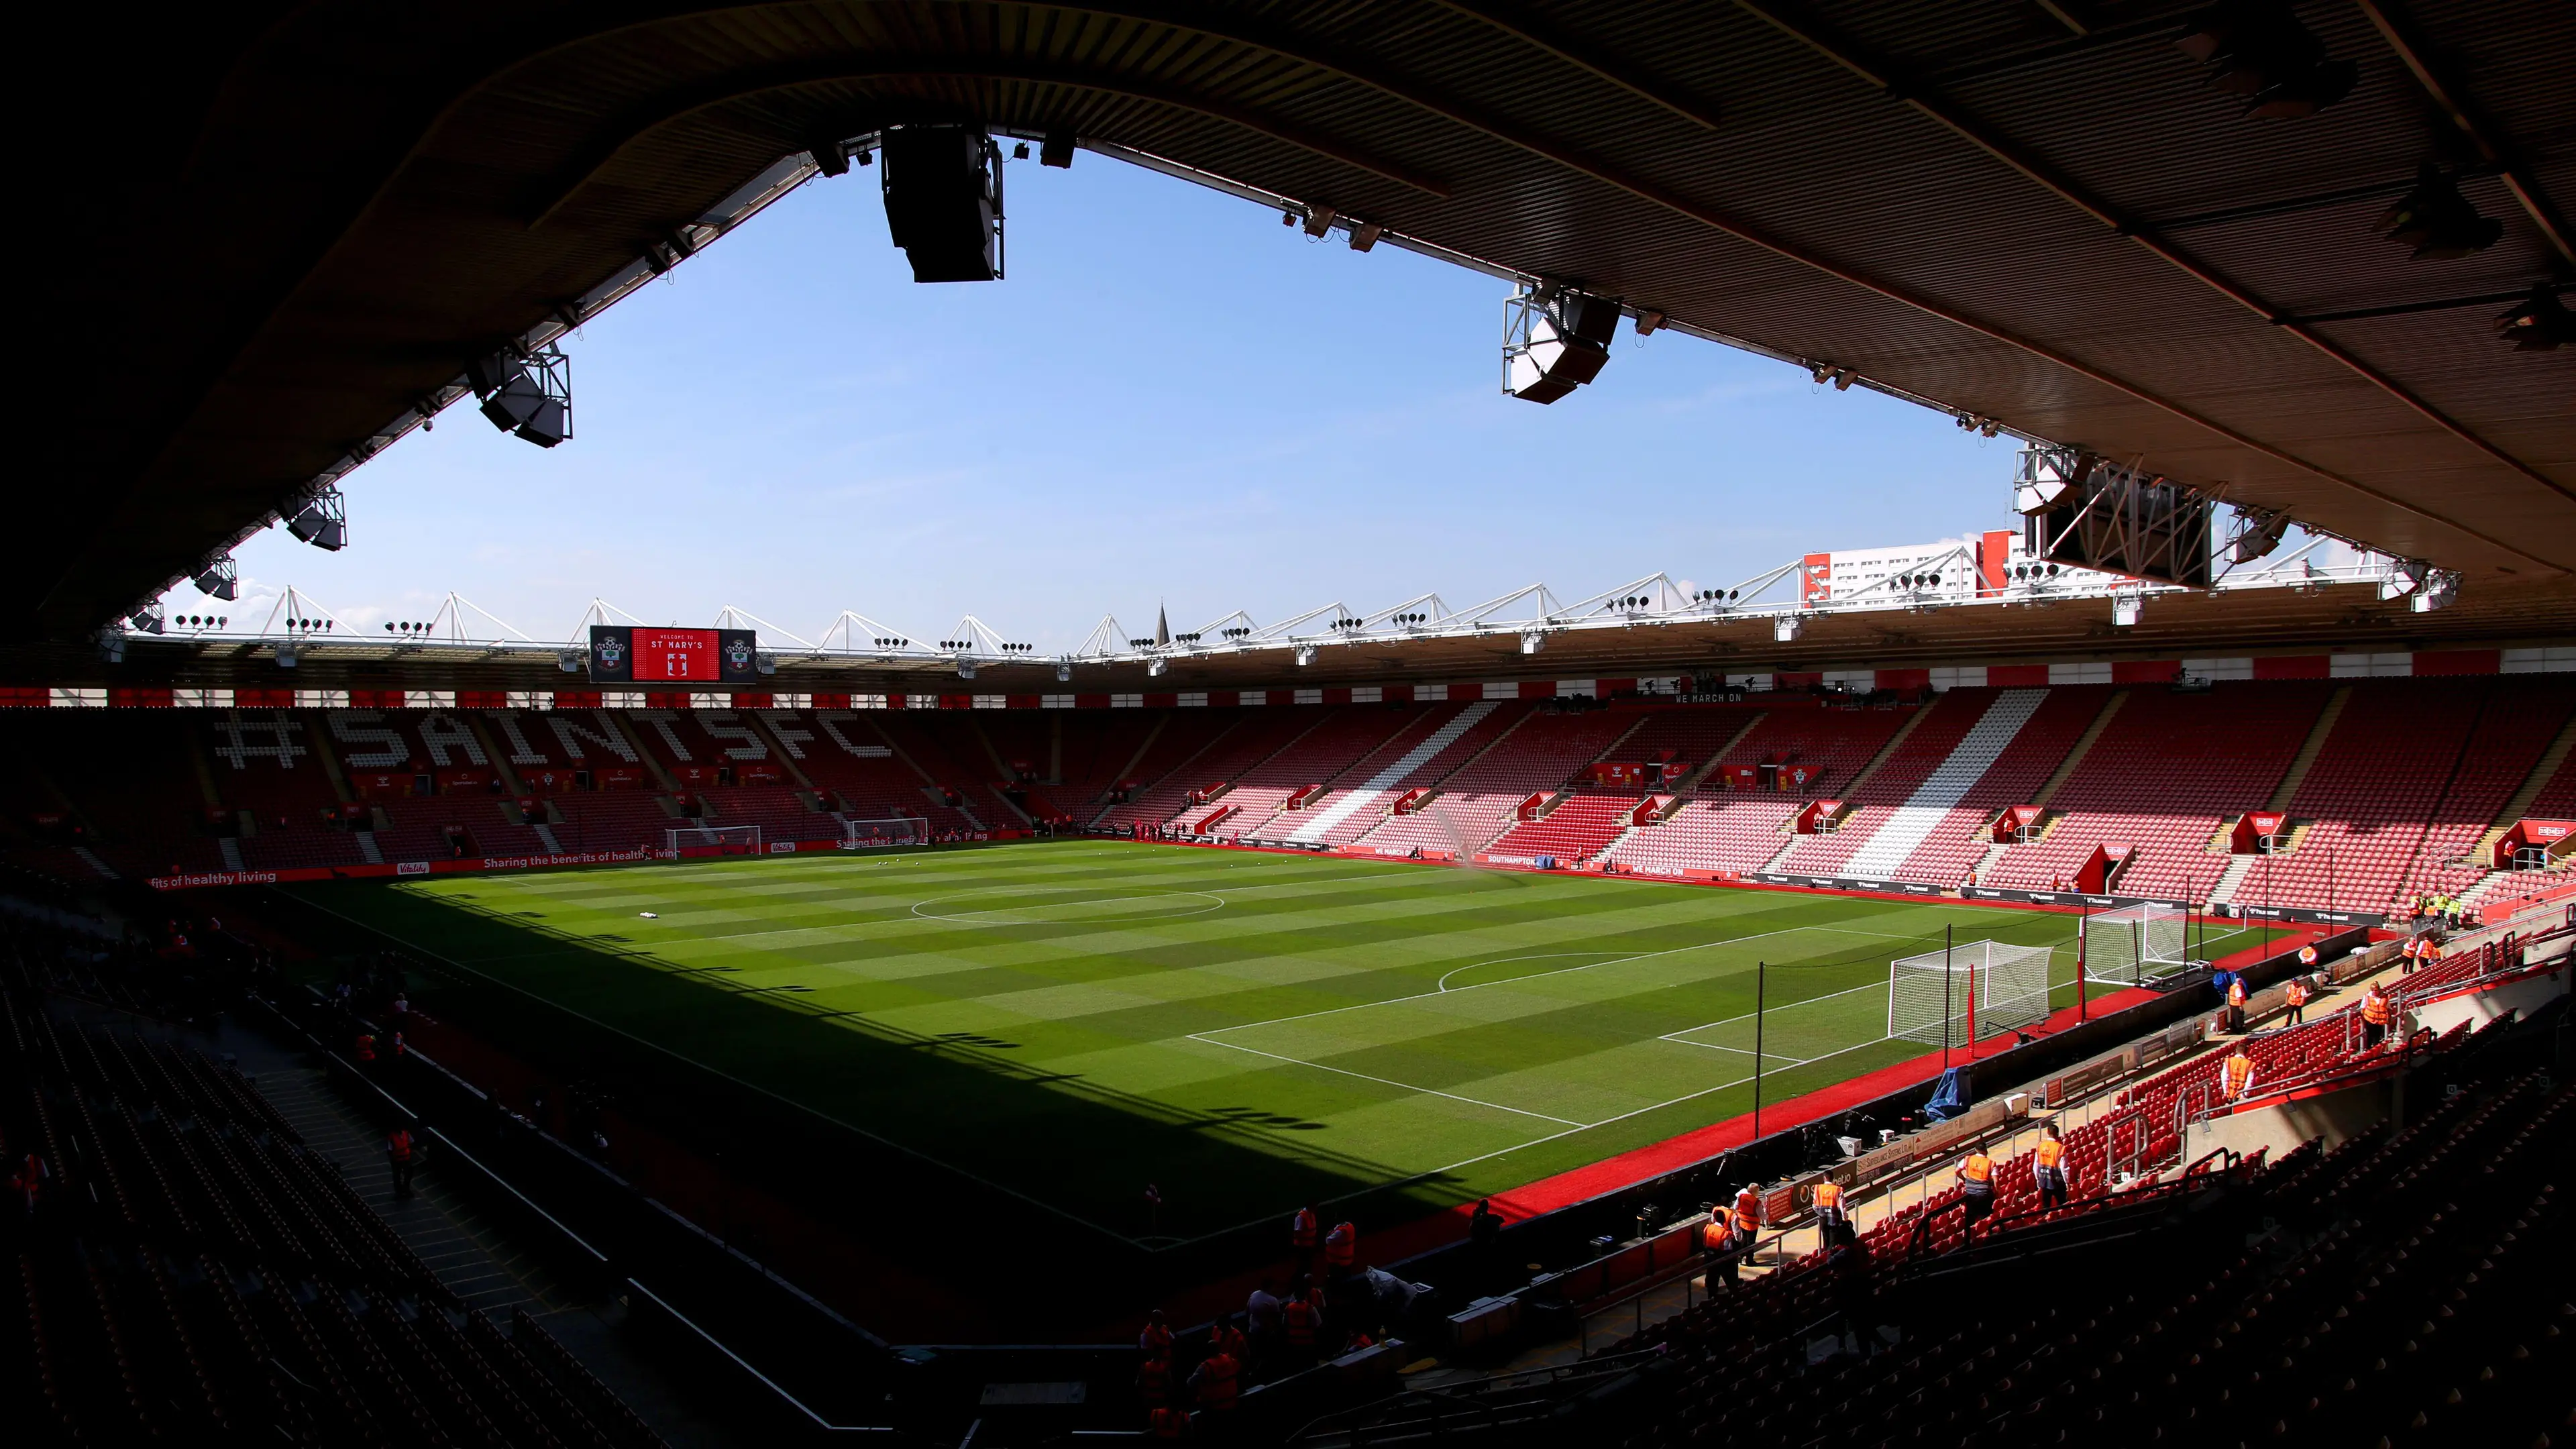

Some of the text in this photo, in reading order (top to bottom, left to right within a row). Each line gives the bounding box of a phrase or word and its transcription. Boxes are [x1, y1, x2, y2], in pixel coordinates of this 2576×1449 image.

[1676, 694, 1741, 703] WE MARCH ON
[871, 837, 885, 846] the
[965, 832, 987, 841] liing
[773, 843, 794, 852] Vitality
[484, 857, 527, 868] Sharing
[530, 855, 549, 865] the
[598, 851, 610, 861] of
[612, 849, 649, 861] health
[1488, 855, 1536, 865] SOUTHAMPTON
[400, 863, 426, 873] Vitality
[1632, 865, 1684, 875] WE MARCH ON
[171, 875, 182, 886] of
[184, 873, 235, 885] healthy
[239, 871, 276, 883] living
[2256, 908, 2279, 916] hummel
[1770, 1189, 1790, 1202] WARNING
